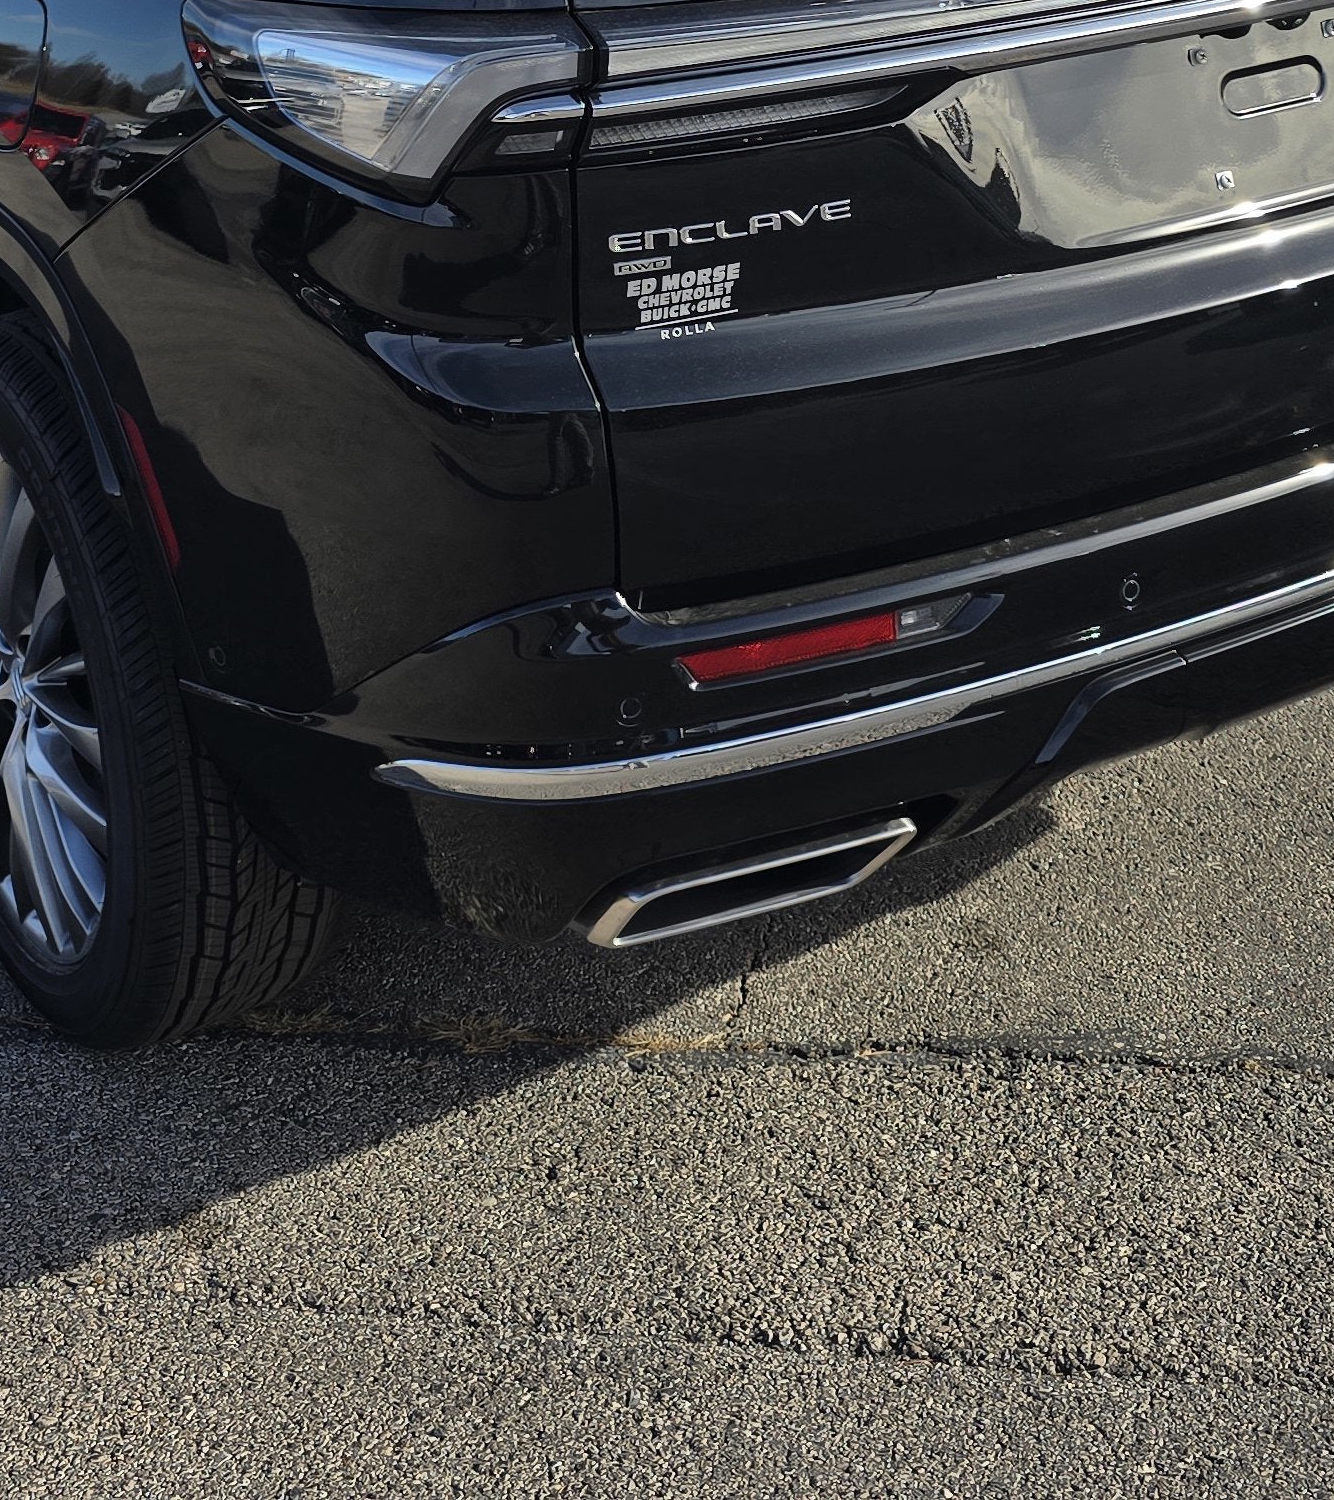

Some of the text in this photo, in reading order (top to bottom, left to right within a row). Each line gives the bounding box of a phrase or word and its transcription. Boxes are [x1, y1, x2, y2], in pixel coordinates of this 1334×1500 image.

[608, 198, 852, 253] ENCLAVE
[616, 258, 670, 275] AWD
[626, 261, 741, 298] ED MORSE
[636, 280, 734, 310] CHEVROLET
[659, 321, 716, 341] ROLLA
